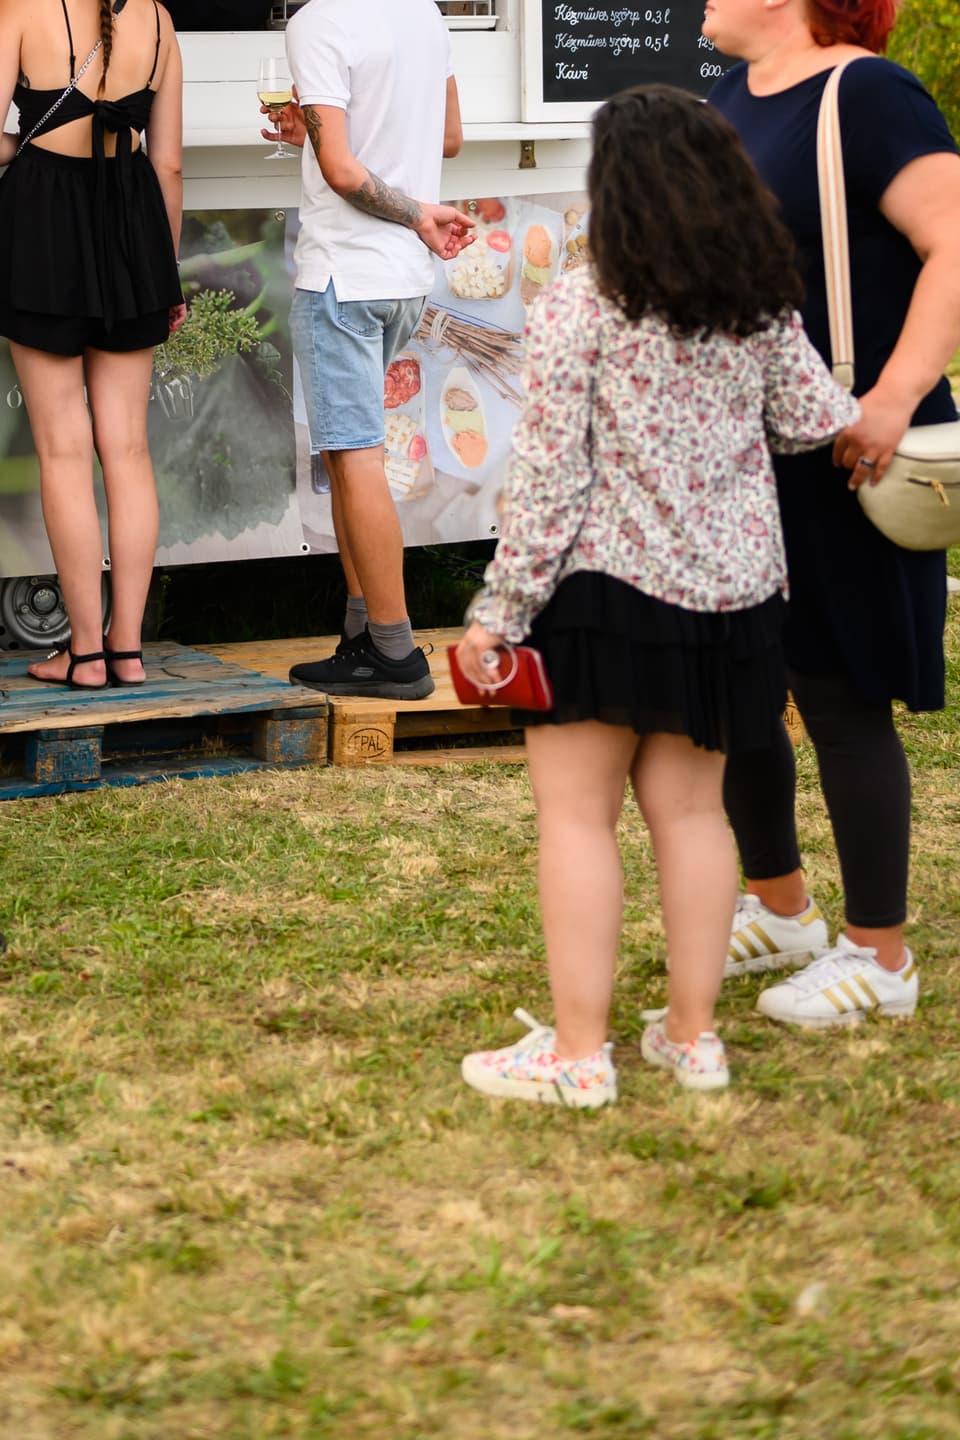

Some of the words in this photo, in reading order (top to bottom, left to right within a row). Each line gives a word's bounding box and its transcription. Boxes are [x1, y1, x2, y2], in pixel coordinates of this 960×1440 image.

[554, 4, 608, 25] Kézműves
[610, 8, 640, 27] szörp
[555, 33, 607, 52] Kézműves
[609, 34, 640, 56] szörp
[556, 62, 588, 80] Kávé
